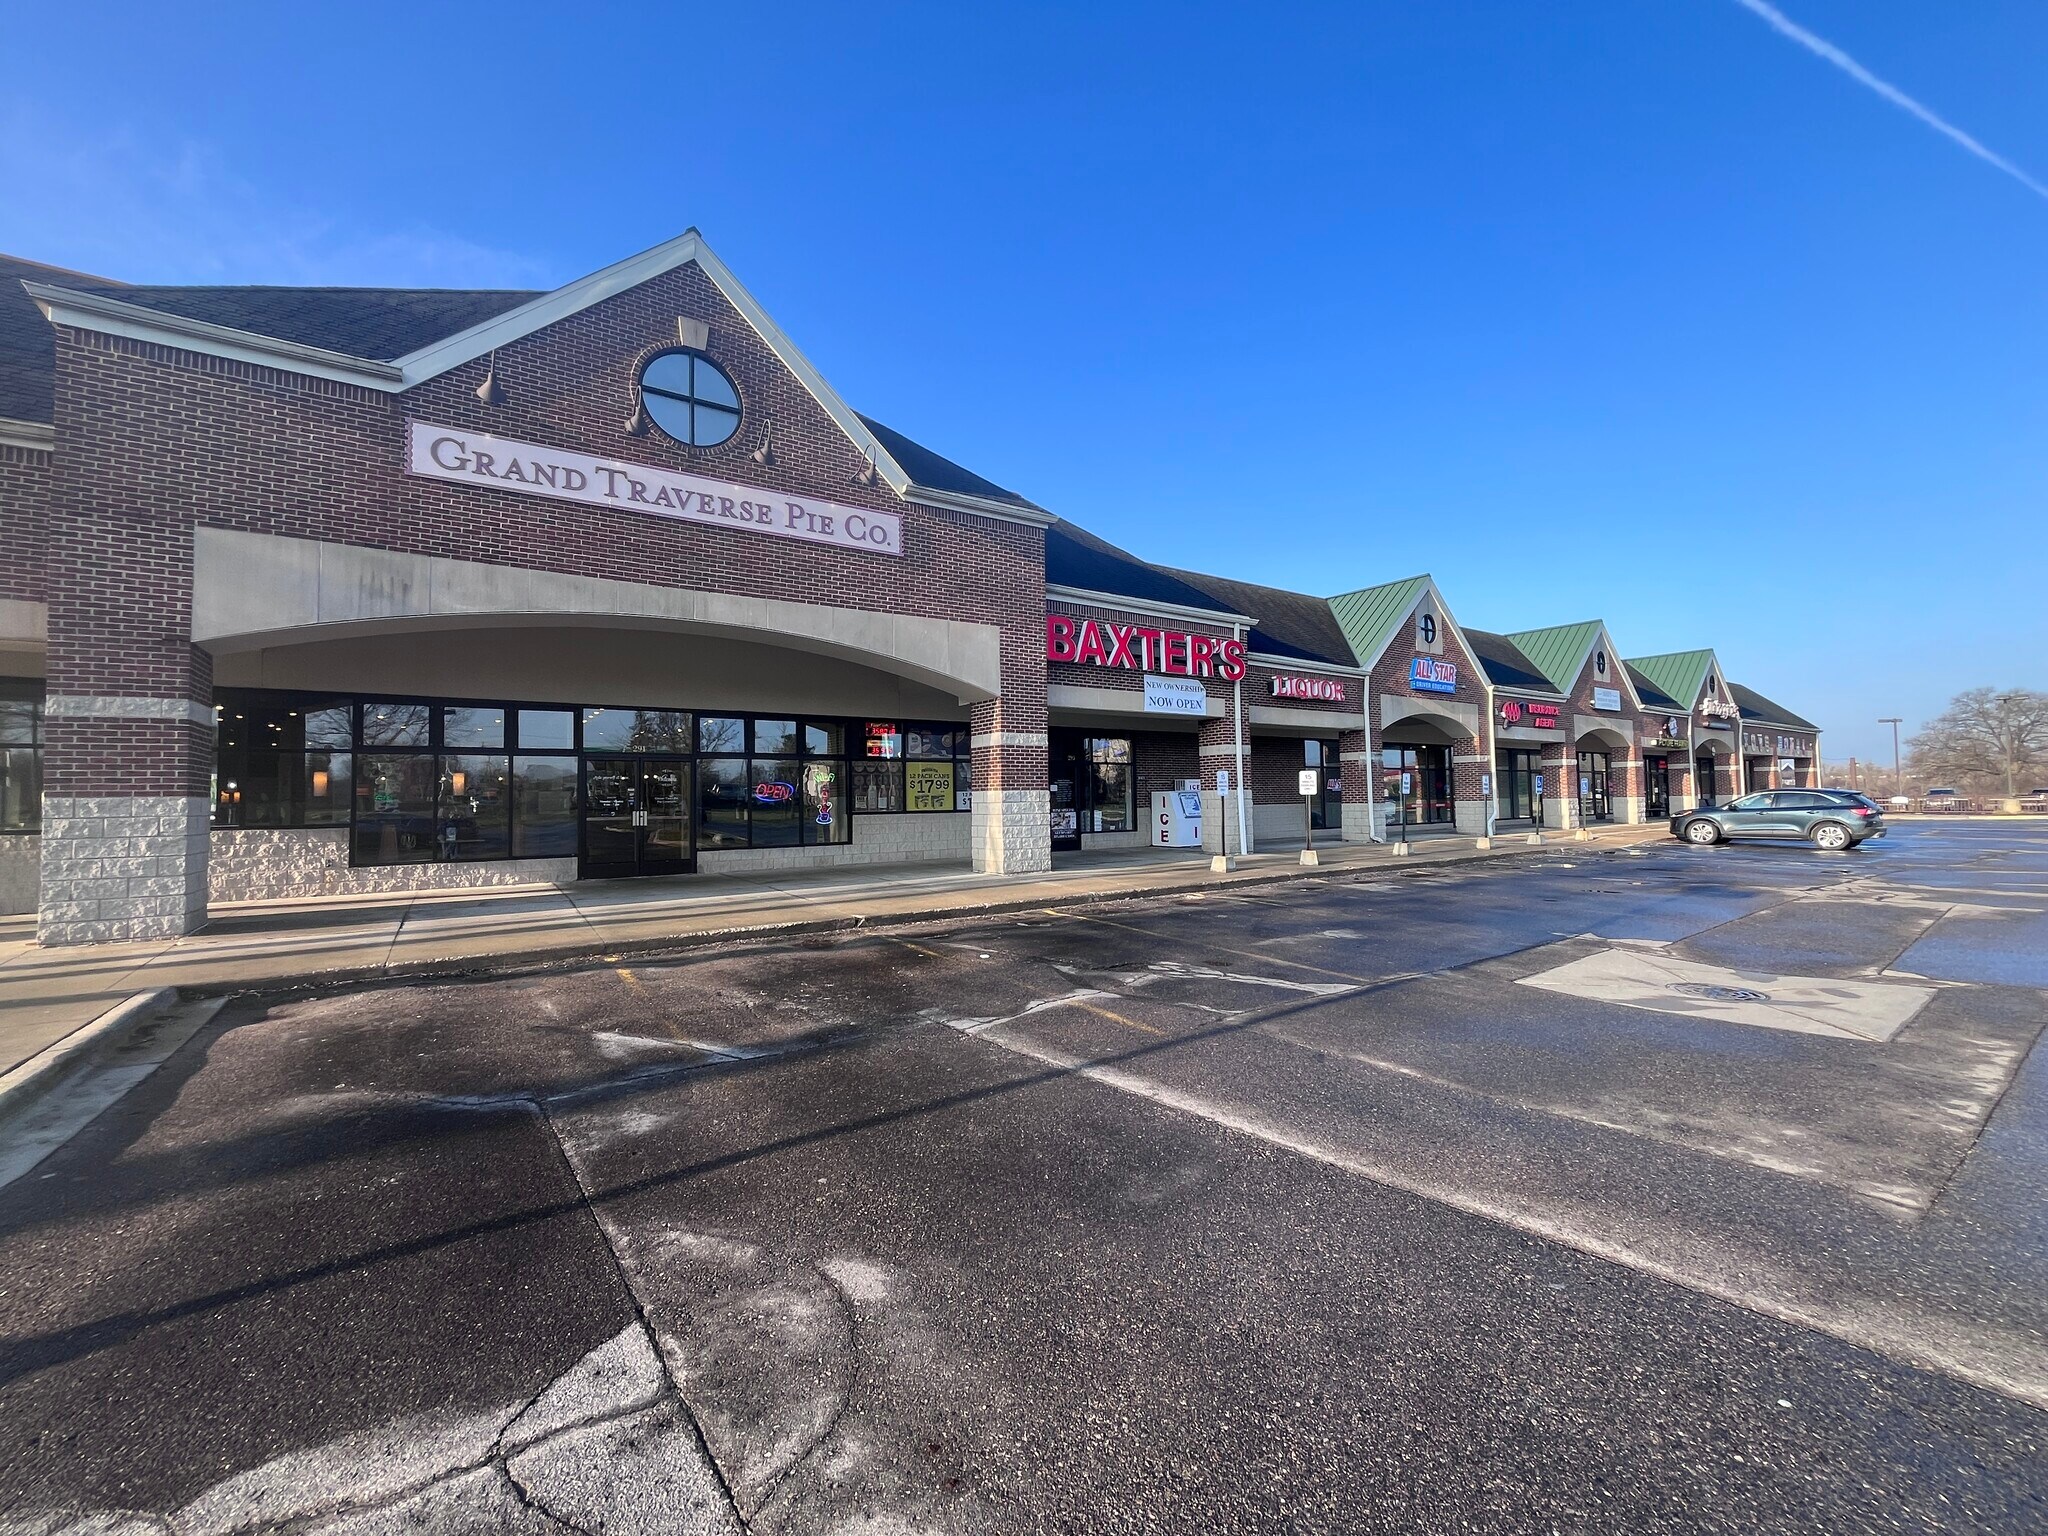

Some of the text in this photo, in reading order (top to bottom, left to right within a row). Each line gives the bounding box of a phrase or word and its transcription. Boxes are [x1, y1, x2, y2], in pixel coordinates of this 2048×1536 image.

[429, 436, 892, 547] GRAND TRAVERSE PIE CO.
[1046, 614, 1246, 681] BAXTER'S
[1416, 660, 1456, 682] ALL STAR
[1146, 681, 1162, 691] NEW
[1272, 675, 1346, 701] LIQUOR
[1149, 695, 1202, 710] NOW OPEN
[756, 783, 791, 800] OPEN
